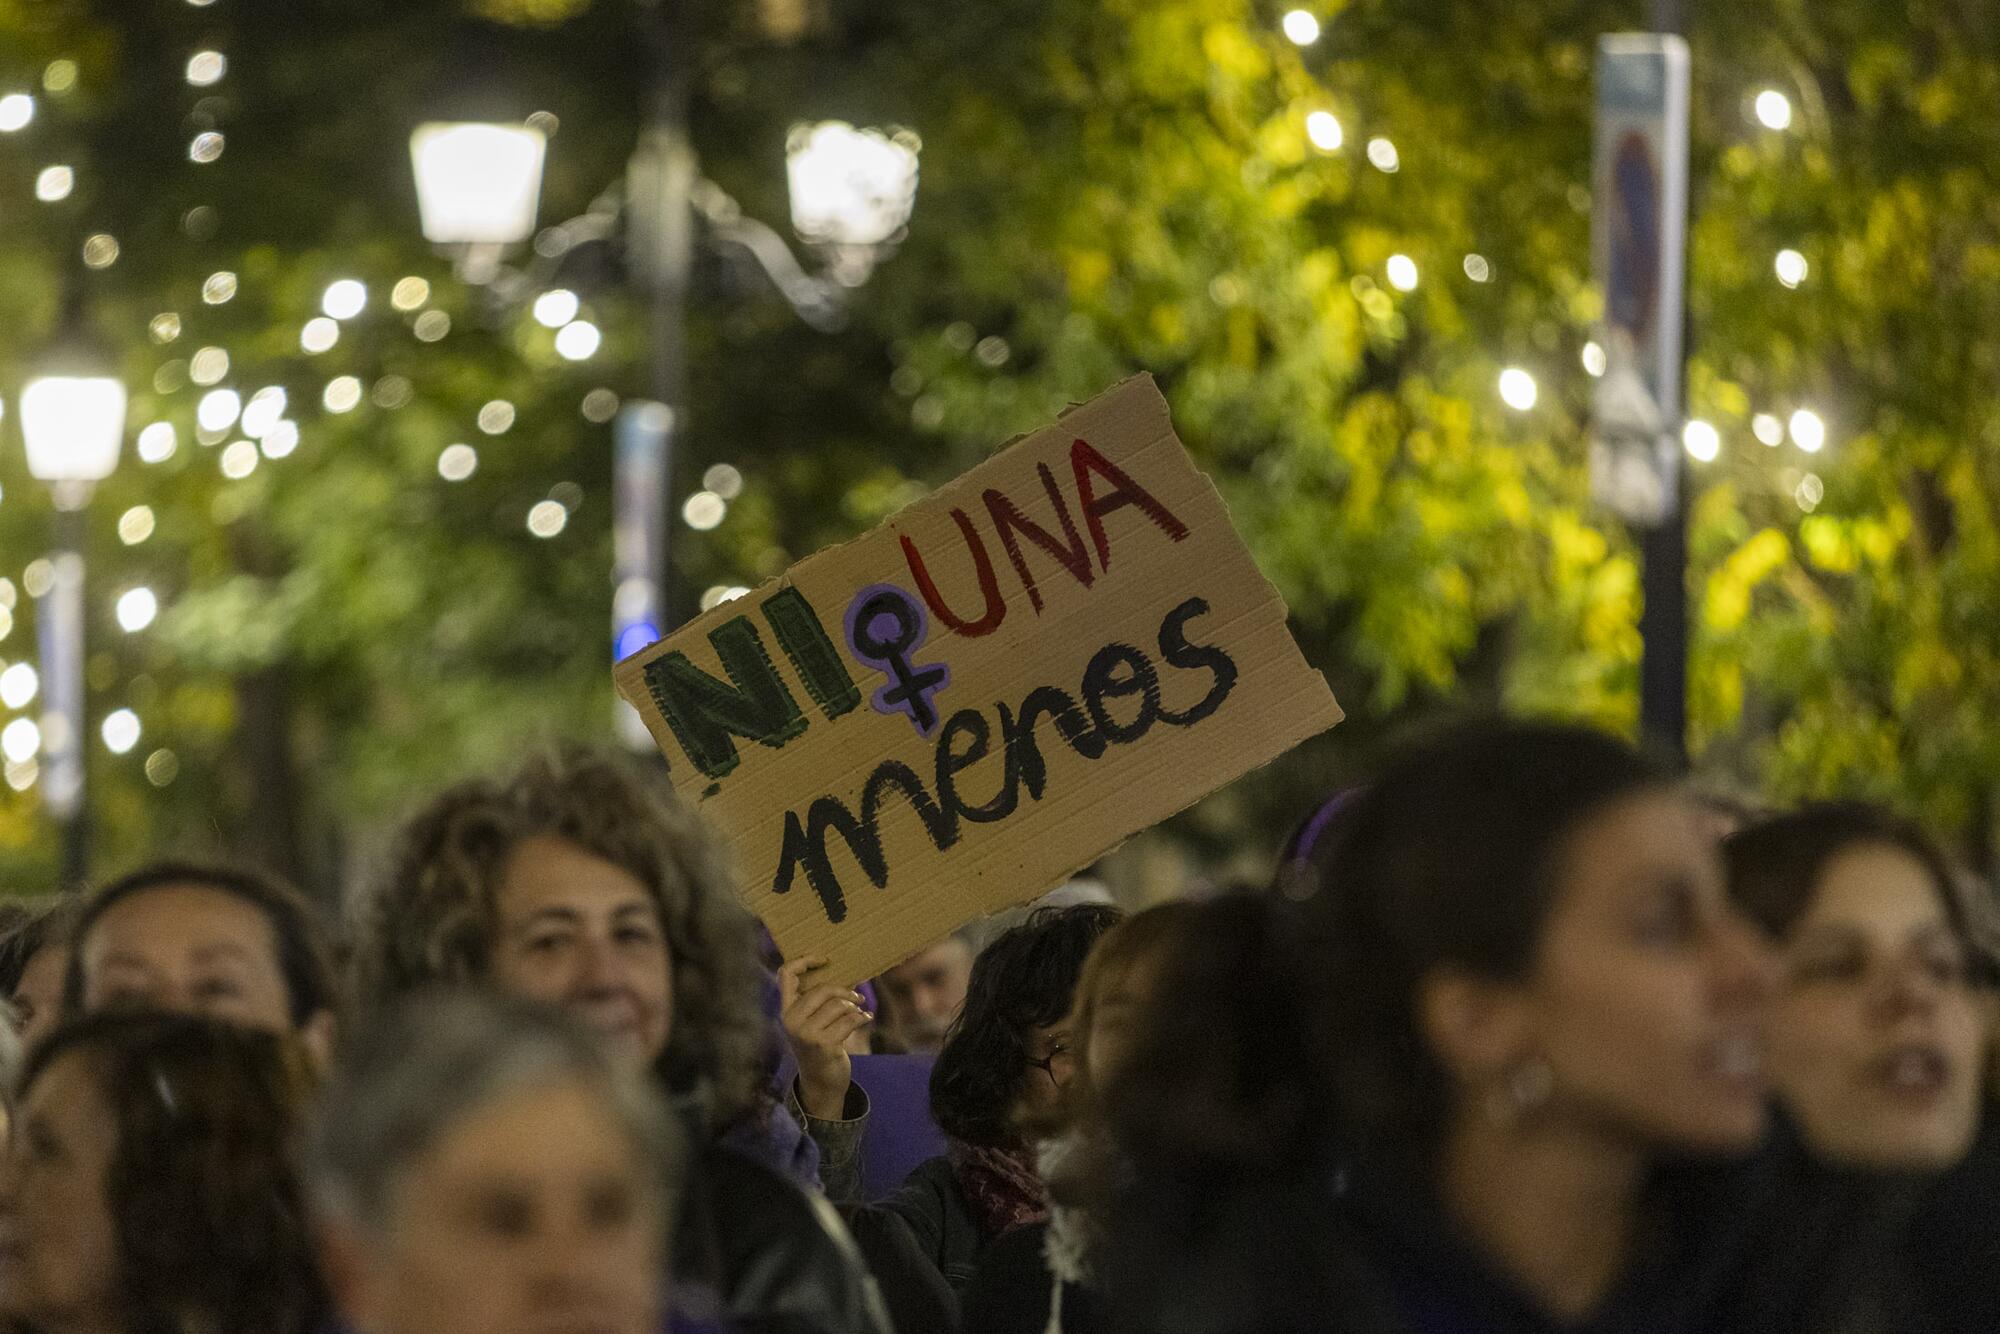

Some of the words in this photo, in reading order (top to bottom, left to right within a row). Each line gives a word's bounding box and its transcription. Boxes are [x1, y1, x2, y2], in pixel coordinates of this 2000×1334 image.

[642, 585, 862, 780] NI
[900, 437, 1190, 640] UNA
[771, 596, 1240, 924] menos
